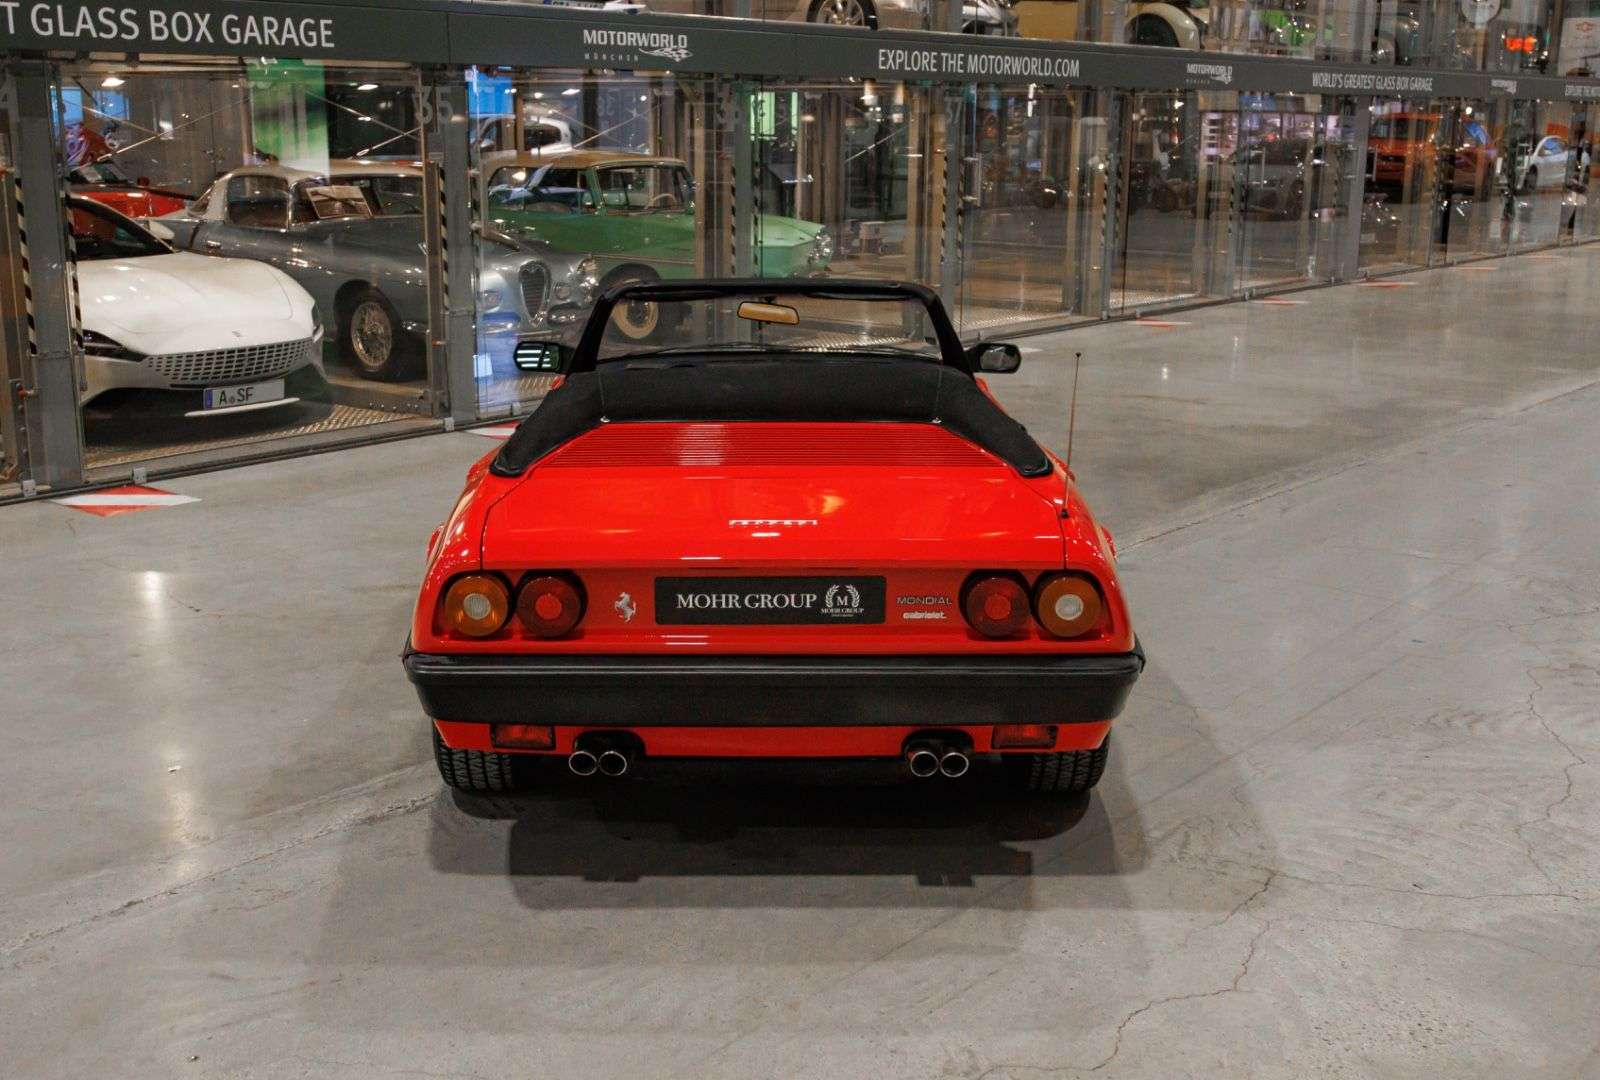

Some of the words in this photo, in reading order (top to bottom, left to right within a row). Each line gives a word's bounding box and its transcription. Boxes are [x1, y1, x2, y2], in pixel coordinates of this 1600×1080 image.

[30, 3, 139, 41] GLASS
[150, 10, 214, 43] BOX
[222, 14, 335, 48] GARAGE
[583, 29, 688, 48] MOTORWORLD
[879, 49, 937, 71] EXPLORE
[941, 52, 964, 73] THE
[968, 54, 1080, 78] MOTORWORLD.COM
[219, 390, 227, 405] A
[237, 387, 254, 402] SF
[676, 593, 741, 609] MOHR
[744, 593, 818, 609] GROUP
[836, 595, 848, 606] M
[896, 596, 953, 605] MONDIAL
